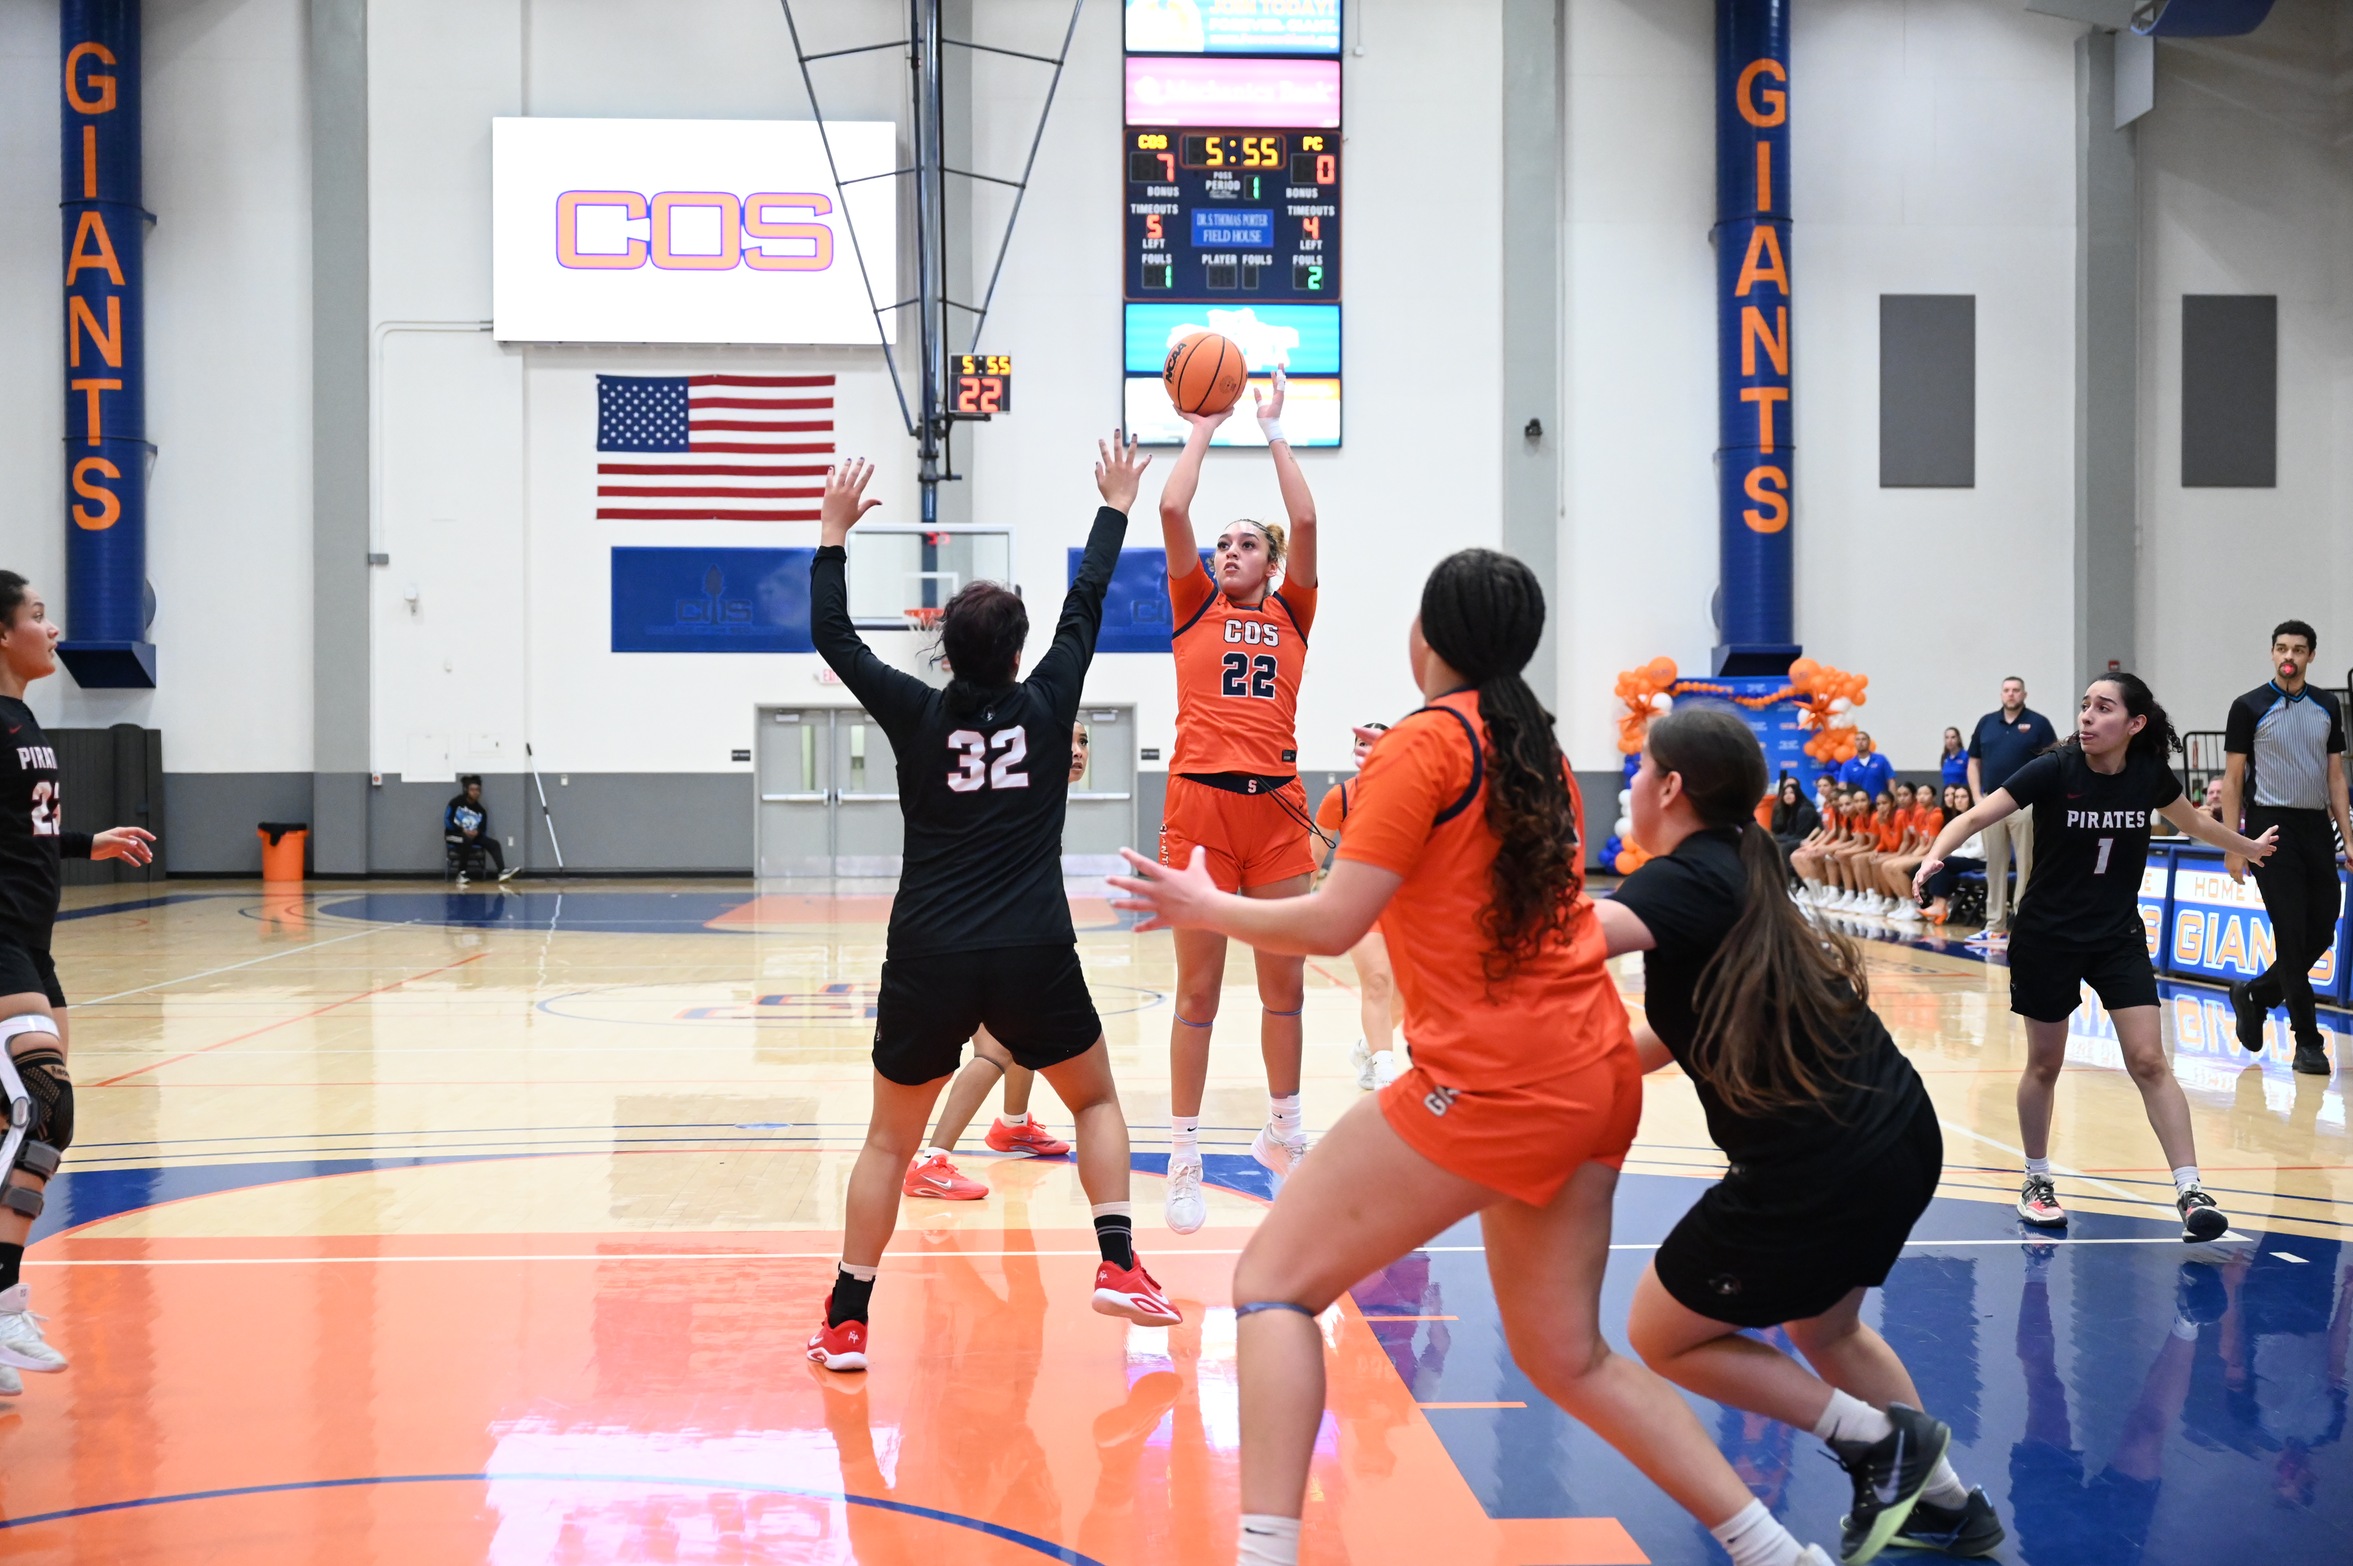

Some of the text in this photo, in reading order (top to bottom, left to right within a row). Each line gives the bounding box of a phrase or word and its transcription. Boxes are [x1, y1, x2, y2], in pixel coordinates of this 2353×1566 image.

[1206, 137, 1278, 166] 5:55
[1302, 136, 1323, 151] PC
[1157, 153, 1175, 182] 7
[1316, 155, 1336, 184] 0
[1147, 186, 1180, 197] BONUS
[1205, 180, 1241, 191] PERIOD
[1253, 176, 1260, 199] 1
[1286, 188, 1318, 198] BONUS
[1131, 204, 1179, 215] TIMEOUTS
[1287, 206, 1336, 216] TIMEOUTS
[556, 190, 834, 271] COS
[1146, 214, 1163, 239] 5
[1203, 229, 1262, 243] FIELD HOUSE
[1302, 216, 1320, 240] 4
[1142, 239, 1165, 249] LEFT
[1300, 240, 1323, 250] LEFT
[1142, 254, 1172, 264] FOULS
[1202, 254, 1273, 265] PLAYER FOULS
[1293, 255, 1323, 265] FOULS
[65, 41, 126, 531] GIANTS
[1165, 265, 1172, 289] 1
[1308, 266, 1323, 290] 2
[1735, 58, 1790, 534] GIANTS
[958, 377, 1002, 412] 22
[1223, 619, 1279, 647] COS
[1221, 651, 1278, 699] 22
[946, 724, 1030, 793] 32
[2066, 810, 2146, 828] PIRATES
[2093, 838, 2114, 875] 1
[2195, 877, 2246, 901] HOME
